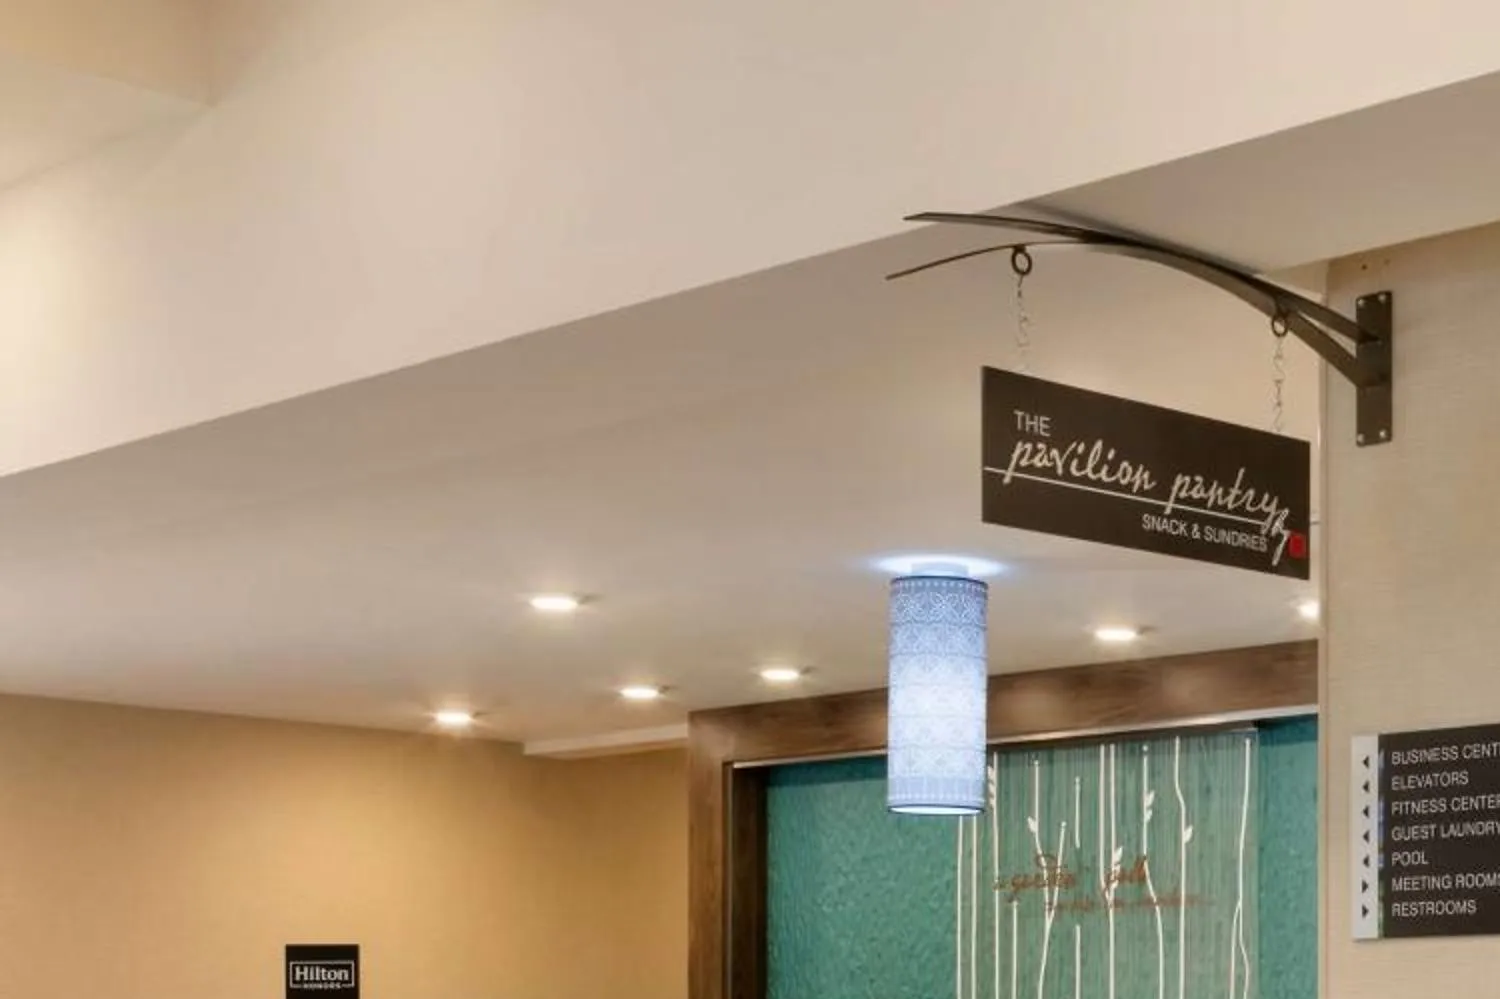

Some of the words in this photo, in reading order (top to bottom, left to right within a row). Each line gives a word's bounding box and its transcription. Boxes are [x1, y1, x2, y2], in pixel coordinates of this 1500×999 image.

[1013, 410, 1051, 436] THE
[1003, 438, 1157, 493] pavilion
[1164, 467, 1281, 536] pantry
[1142, 513, 1188, 537] SNACK
[1191, 523, 1201, 539] &
[1203, 525, 1269, 552] SUNDRIES
[1391, 745, 1459, 765] BUSINESS
[1391, 771, 1469, 790] ELEVATORS
[1391, 798, 1448, 815] FITNESS
[1391, 824, 1437, 841] GUEST
[1391, 851, 1429, 867] POOL
[1391, 875, 1452, 891] MEETING
[1391, 899, 1477, 917] RESTROOMS
[295, 965, 349, 981] Hilton
